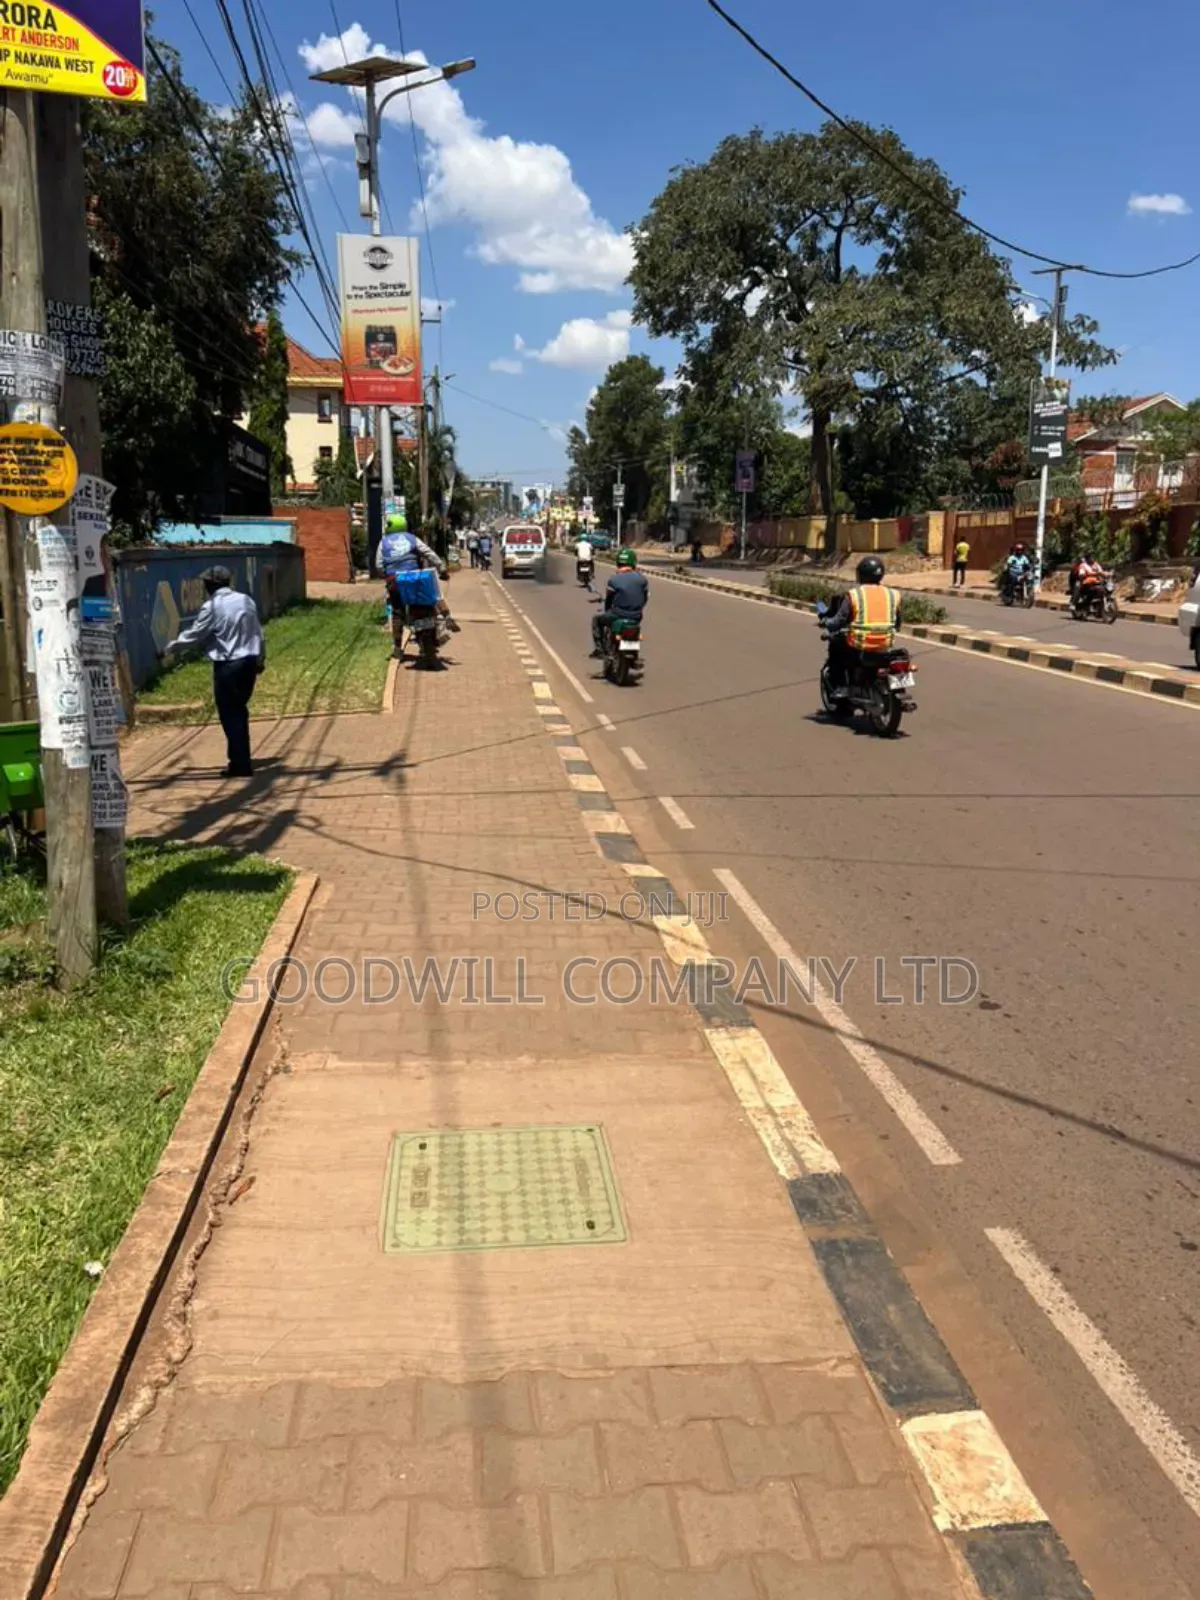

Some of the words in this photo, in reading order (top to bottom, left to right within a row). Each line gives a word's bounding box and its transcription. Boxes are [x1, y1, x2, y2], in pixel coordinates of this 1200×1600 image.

[0, 26, 16, 43] RT
[20, 30, 80, 51] ANDERSON
[14, 50, 62, 70] NAKAWA
[64, 58, 95, 74] WEST
[379, 282, 406, 290] Simple
[364, 290, 412, 300] Spectacular
